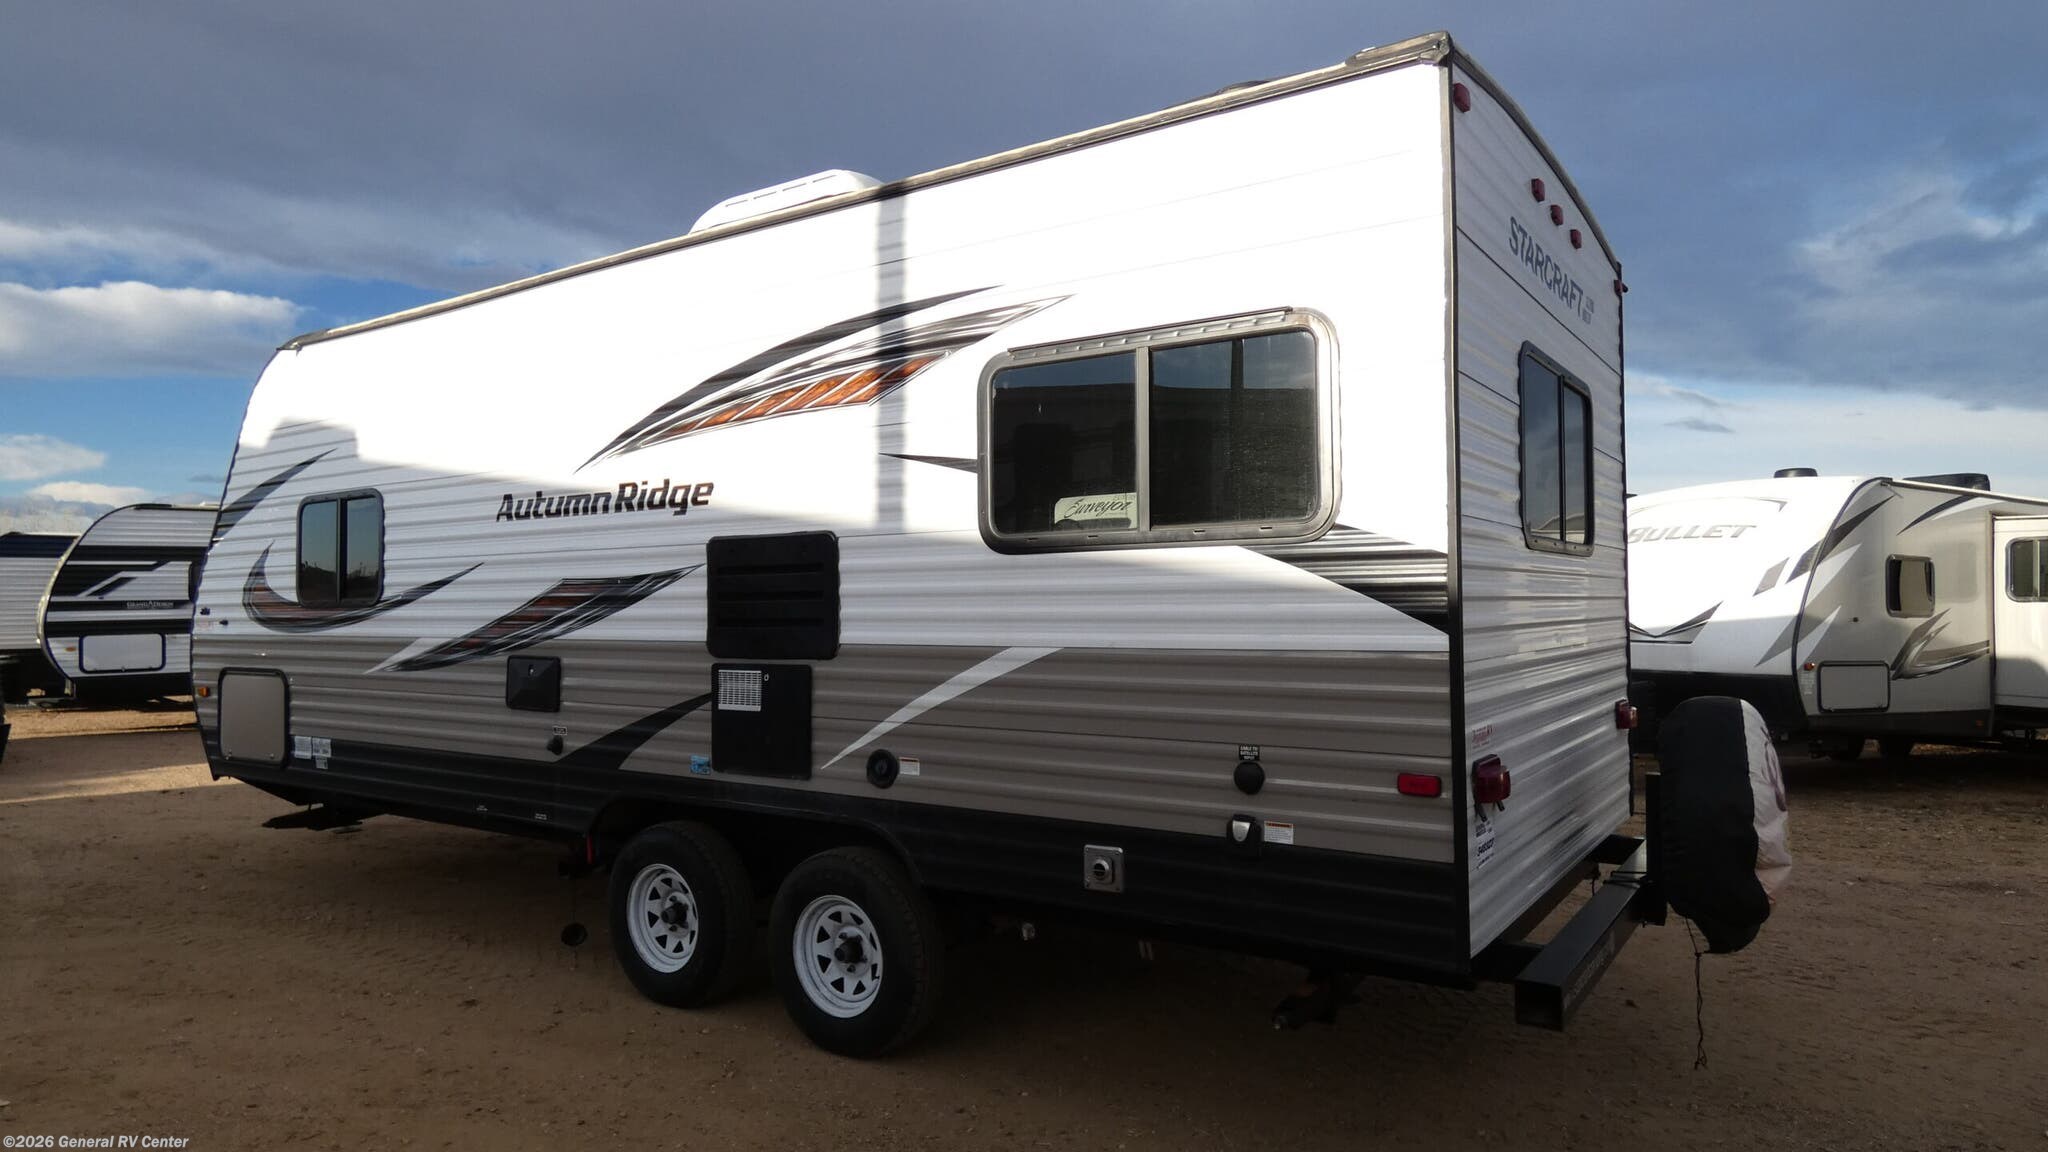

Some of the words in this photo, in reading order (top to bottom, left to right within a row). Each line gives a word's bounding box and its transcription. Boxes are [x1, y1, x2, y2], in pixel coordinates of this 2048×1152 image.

[1509, 216, 1584, 317] STARCRAFT
[496, 490, 612, 522] Autumn
[614, 479, 714, 516] Ridge
[1628, 525, 1757, 543] BULLET
